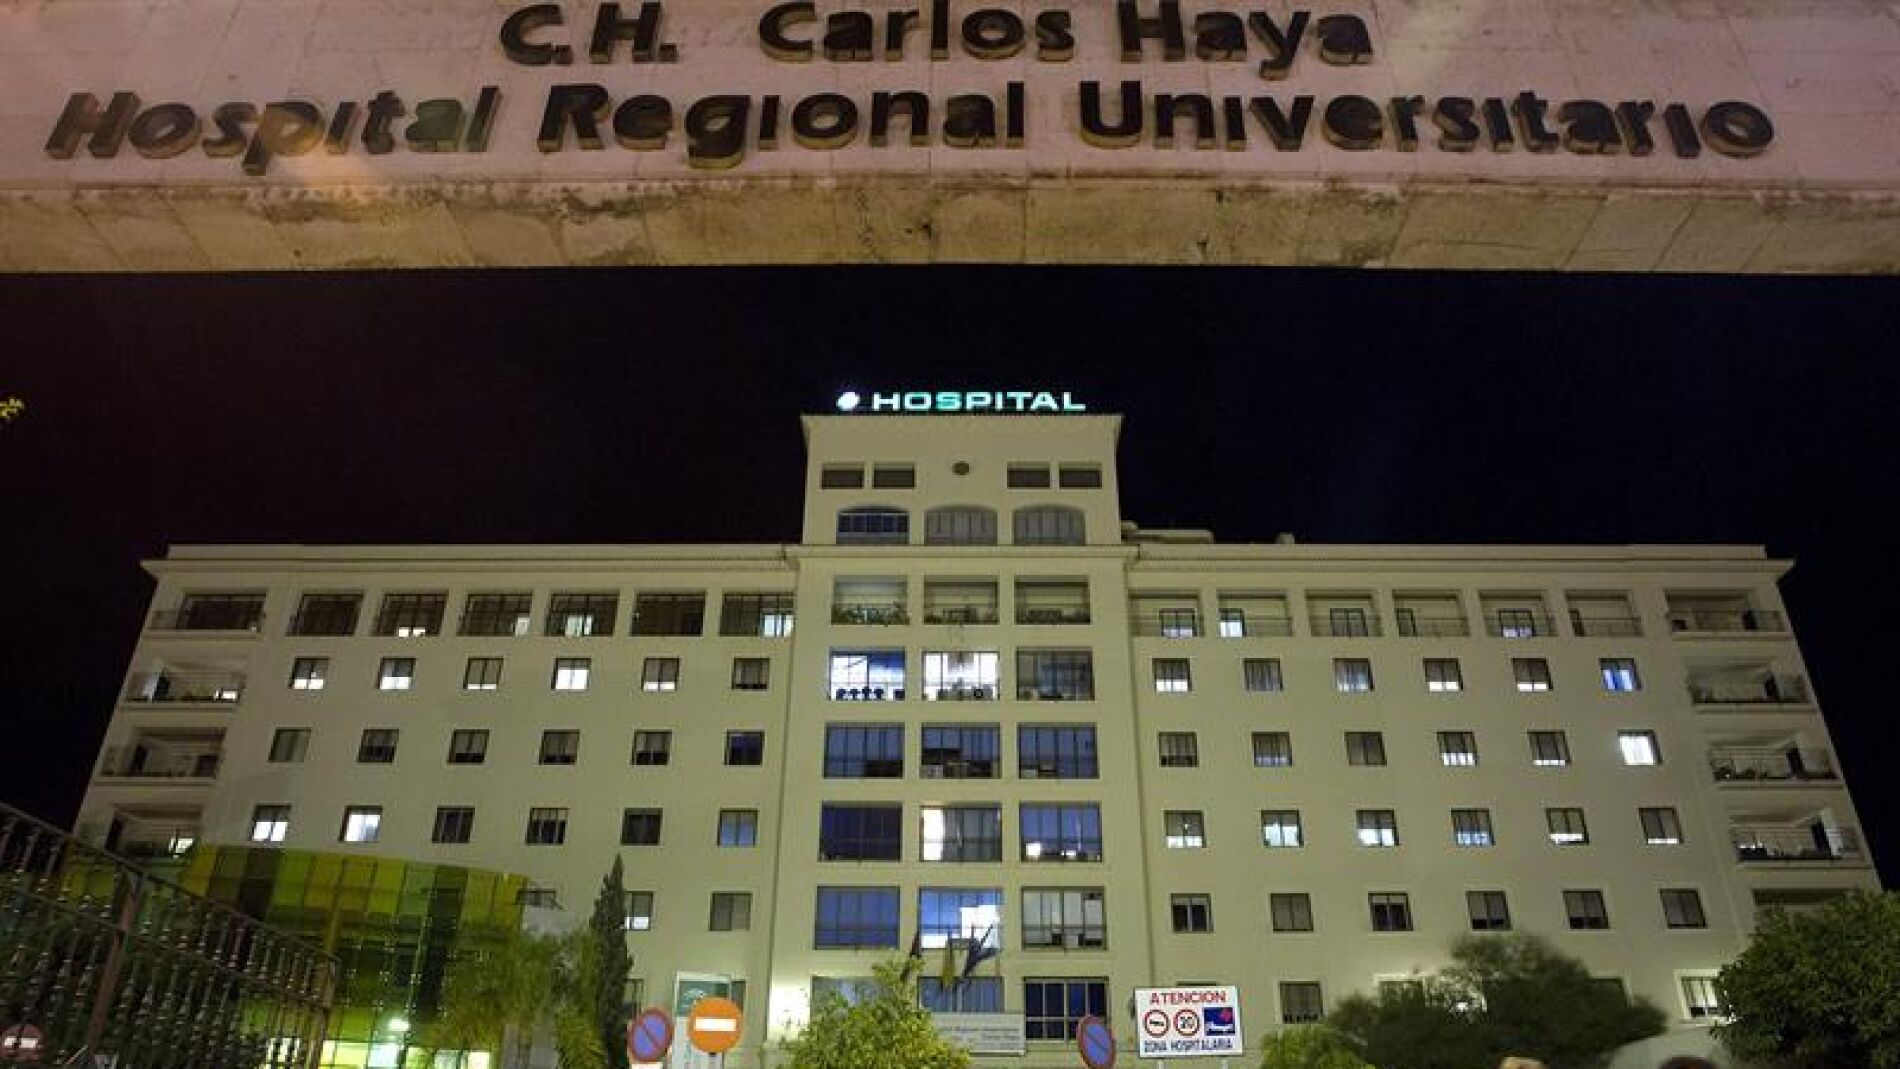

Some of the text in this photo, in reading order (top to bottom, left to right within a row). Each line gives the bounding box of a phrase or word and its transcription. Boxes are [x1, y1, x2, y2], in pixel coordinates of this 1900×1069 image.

[758, 0, 1075, 62] Carlos
[1117, 0, 1373, 79] Haya
[45, 80, 1775, 176] Hospital Regional Universitario
[873, 391, 1086, 411] HOSPITAL
[1150, 990, 1226, 1005] ATENCION
[1144, 1040, 1167, 1053] ZONA
